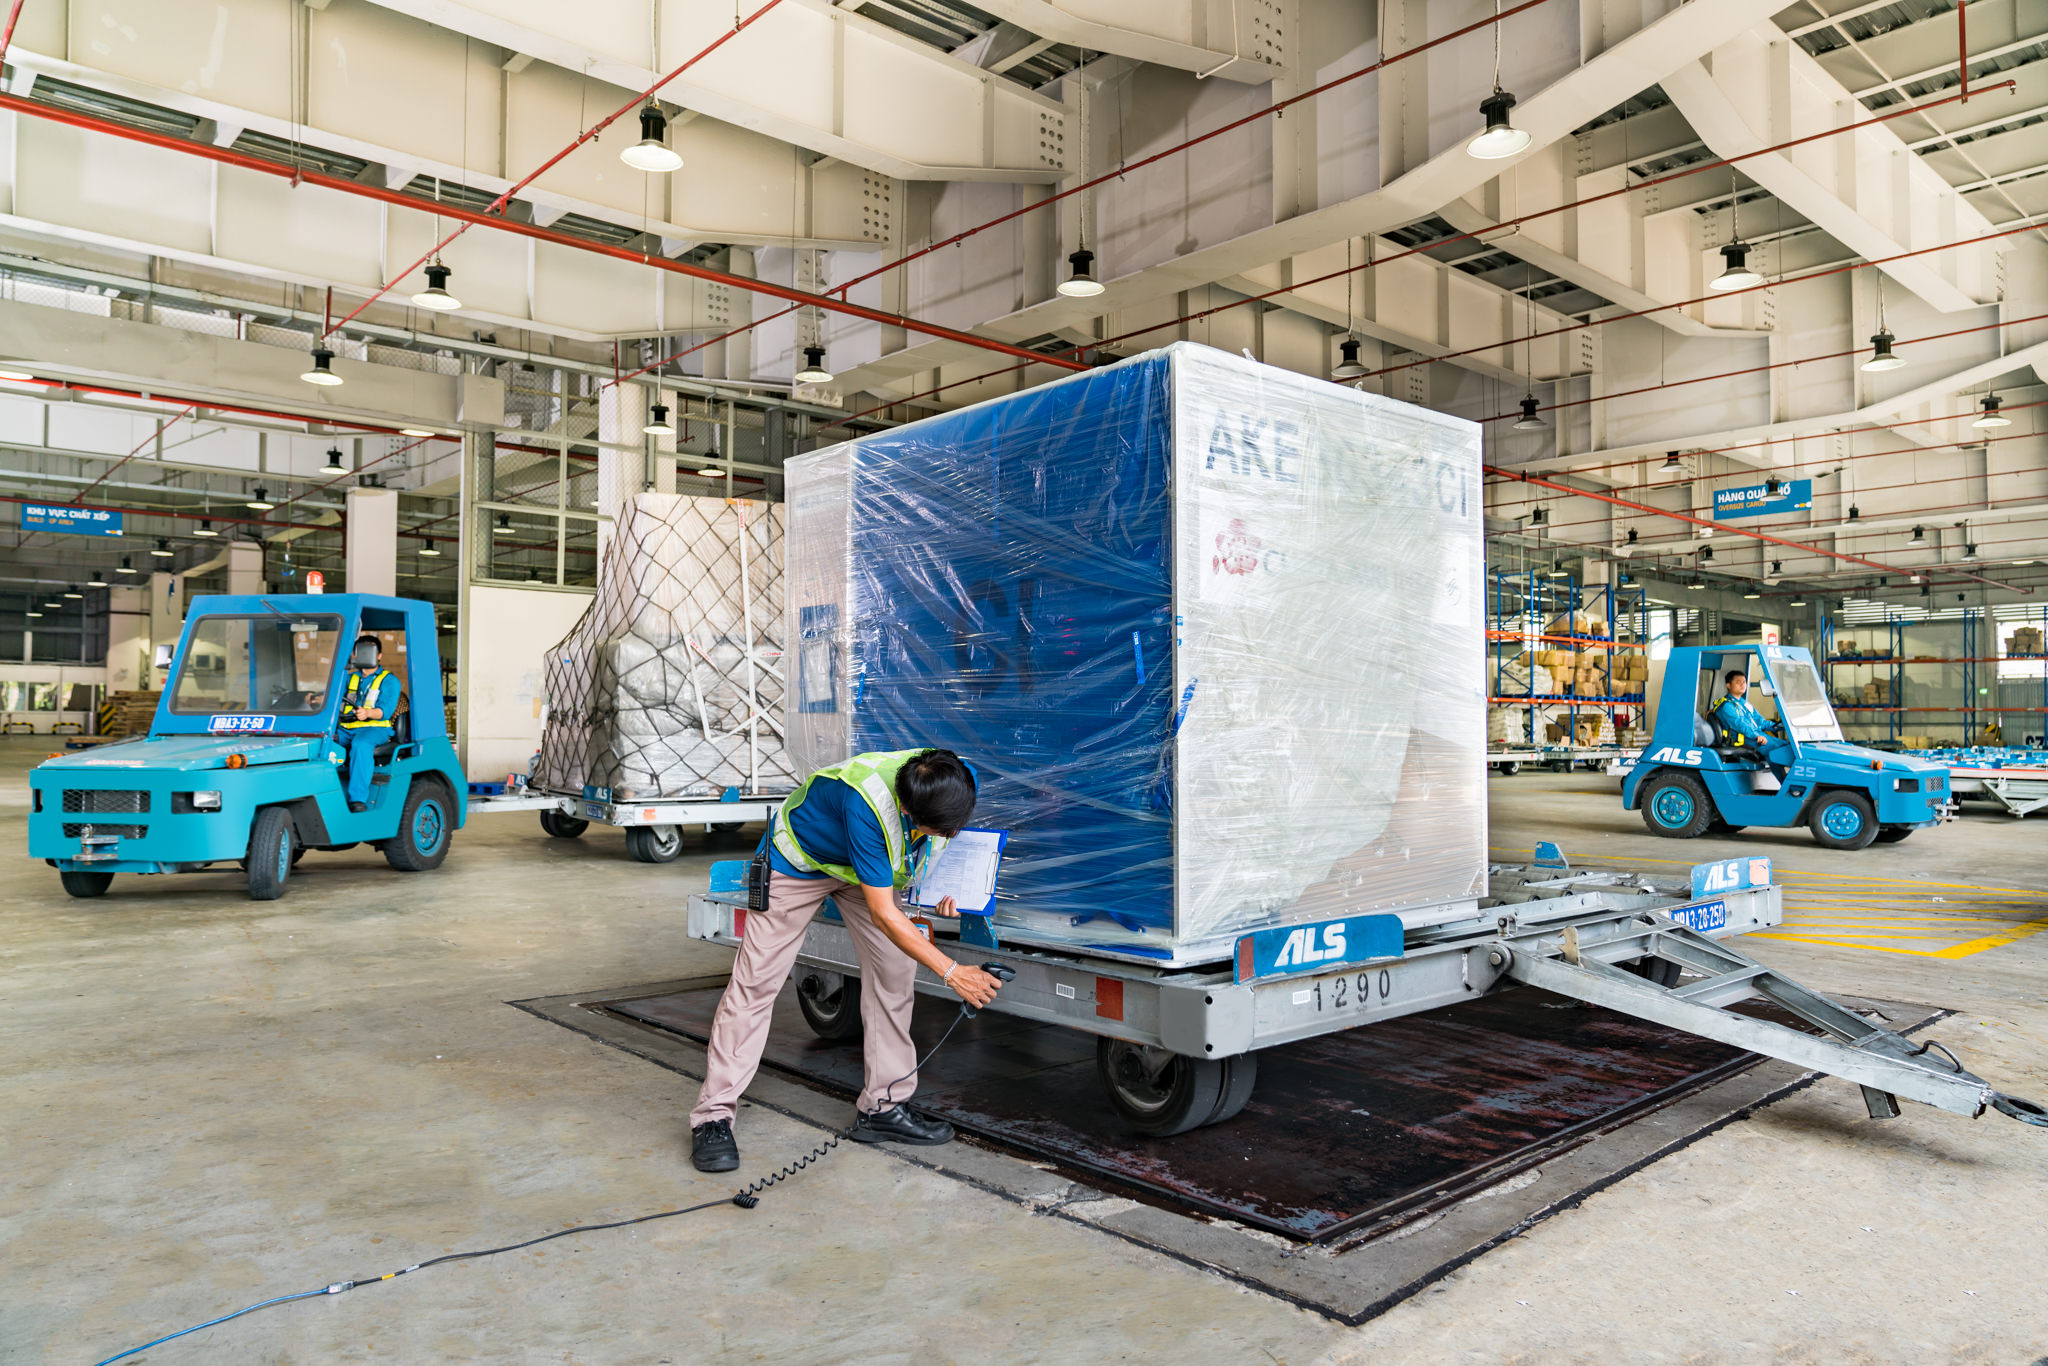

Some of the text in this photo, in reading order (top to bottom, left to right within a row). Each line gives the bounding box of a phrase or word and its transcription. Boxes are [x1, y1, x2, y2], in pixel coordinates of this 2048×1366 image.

[1205, 409, 1299, 483] AKE
[1718, 491, 1745, 503] HÀNG
[1746, 486, 1767, 499] QUÁ
[27, 507, 46, 516] KHU
[1718, 500, 1766, 511] OVERSIZE CARGO
[1623, 758, 1637, 766] AL
[1651, 747, 1703, 766] ALS
[1794, 766, 1816, 778] 25
[595, 787, 608, 801] ALS
[1703, 862, 1740, 892] ALS
[1274, 922, 1348, 968] ALS
[1313, 968, 1391, 1012] 1290
